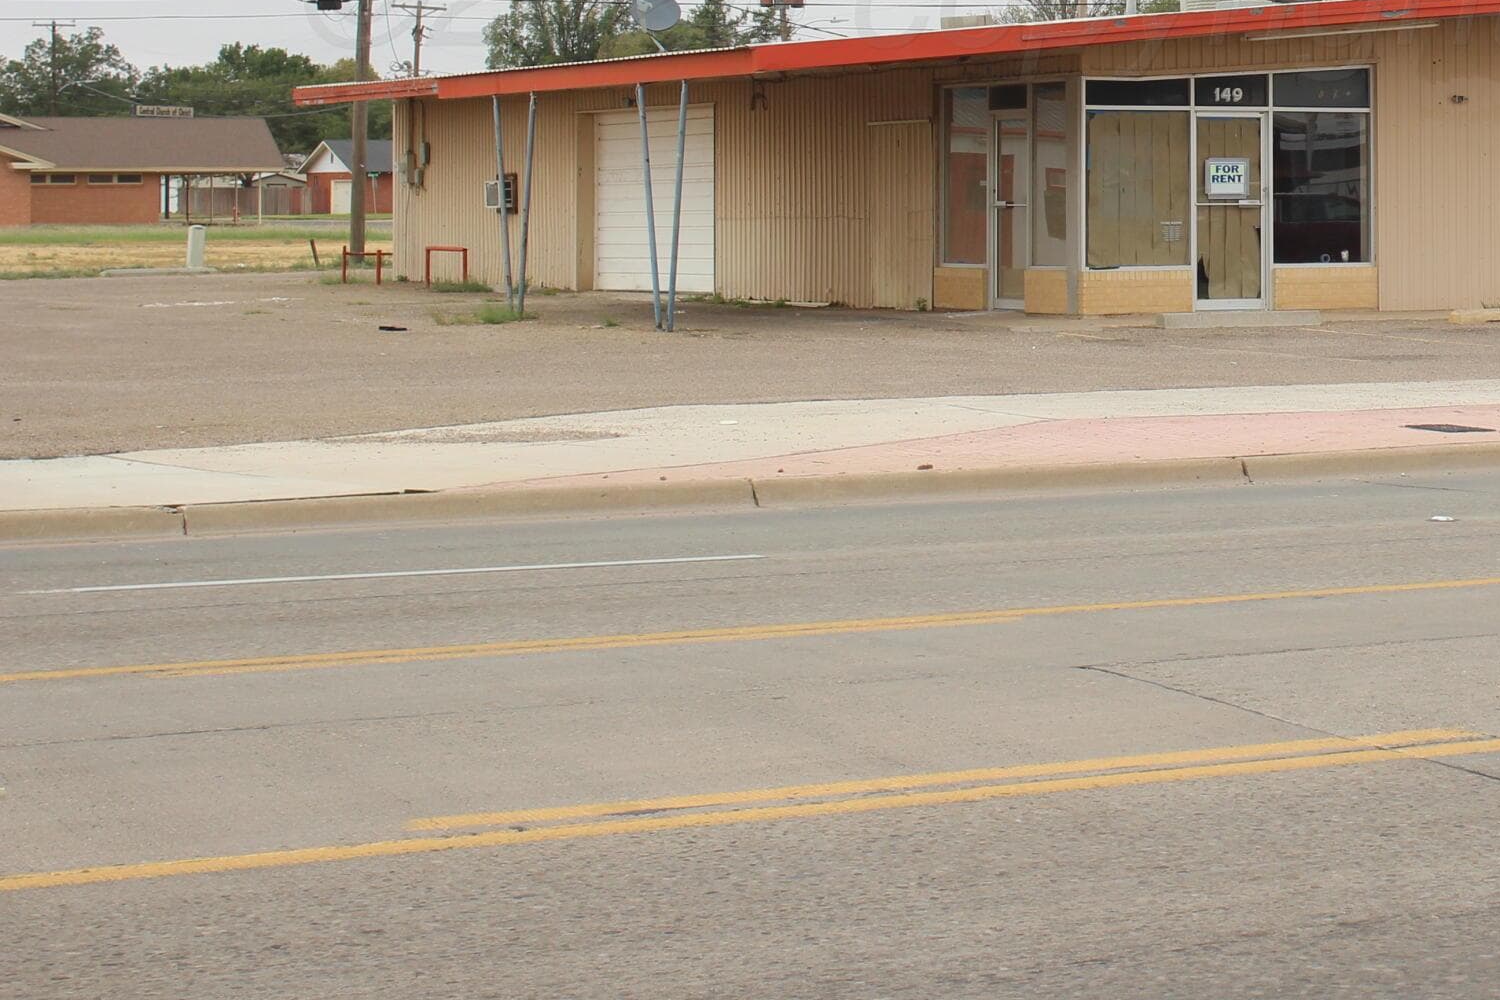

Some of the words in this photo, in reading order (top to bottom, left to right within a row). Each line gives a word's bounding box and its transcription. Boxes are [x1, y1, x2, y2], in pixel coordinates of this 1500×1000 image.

[1213, 87, 1243, 102] 149
[1215, 164, 1240, 174] FOR
[1211, 174, 1243, 184] RENT
